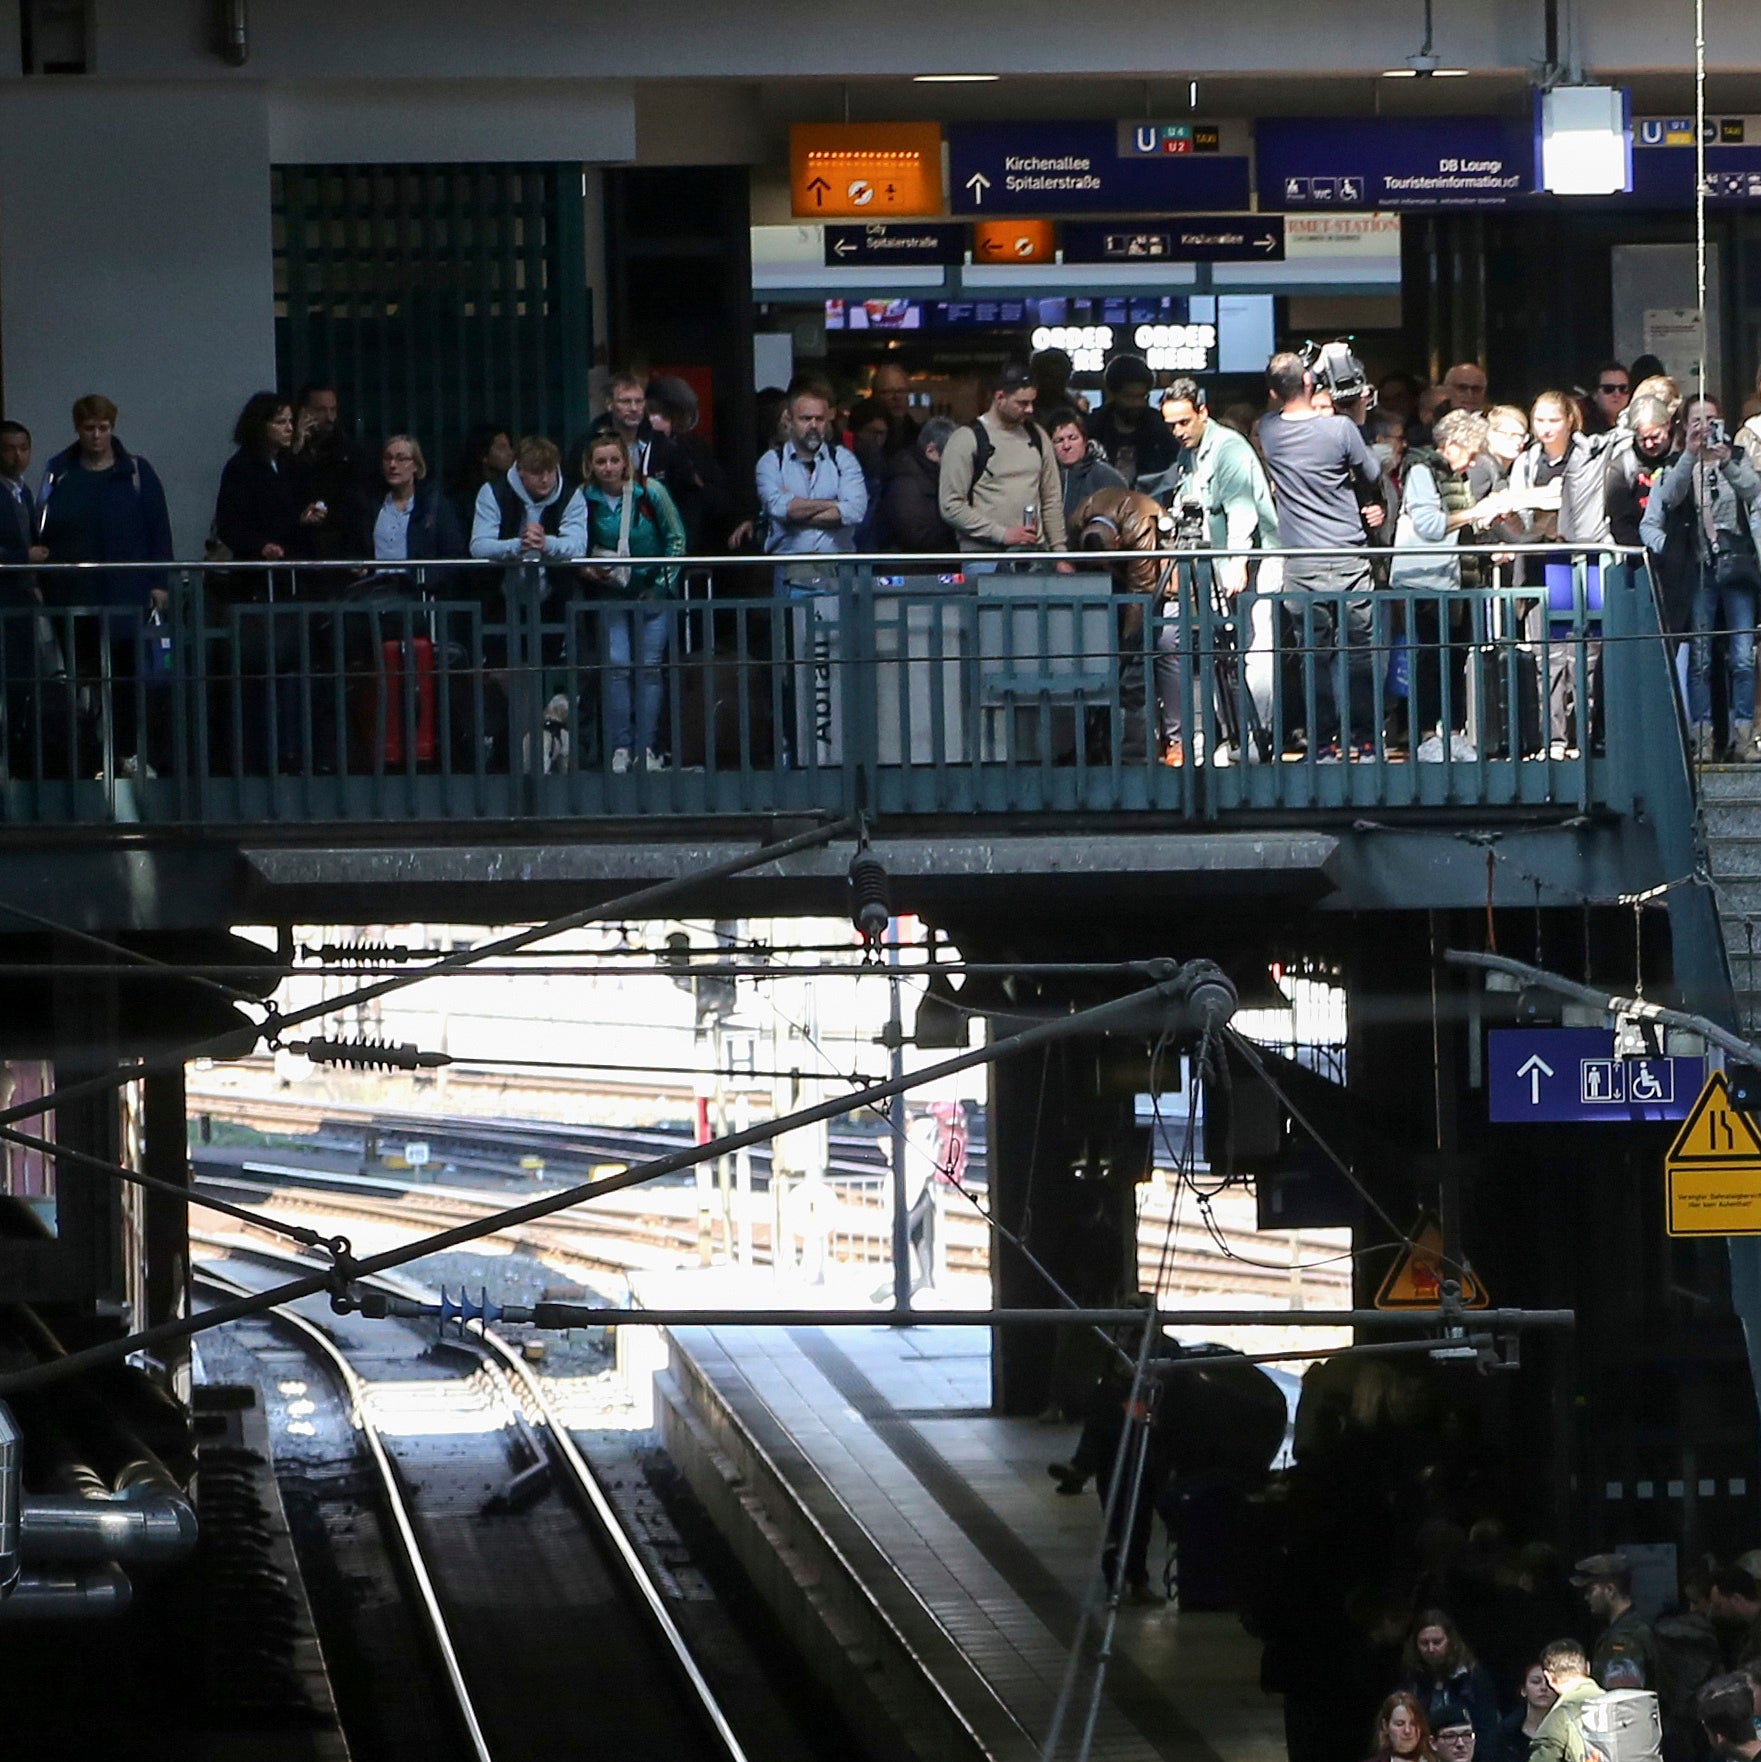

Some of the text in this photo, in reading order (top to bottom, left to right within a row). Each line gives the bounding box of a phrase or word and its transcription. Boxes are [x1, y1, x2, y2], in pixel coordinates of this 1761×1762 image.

[1005, 156, 1091, 172] Kirchenallee
[1005, 175, 1100, 194] Spitalerstraße
[866, 236, 938, 250] Spitalerstraße
[1134, 325, 1217, 348] ORDER
[1146, 347, 1208, 370] HERE
